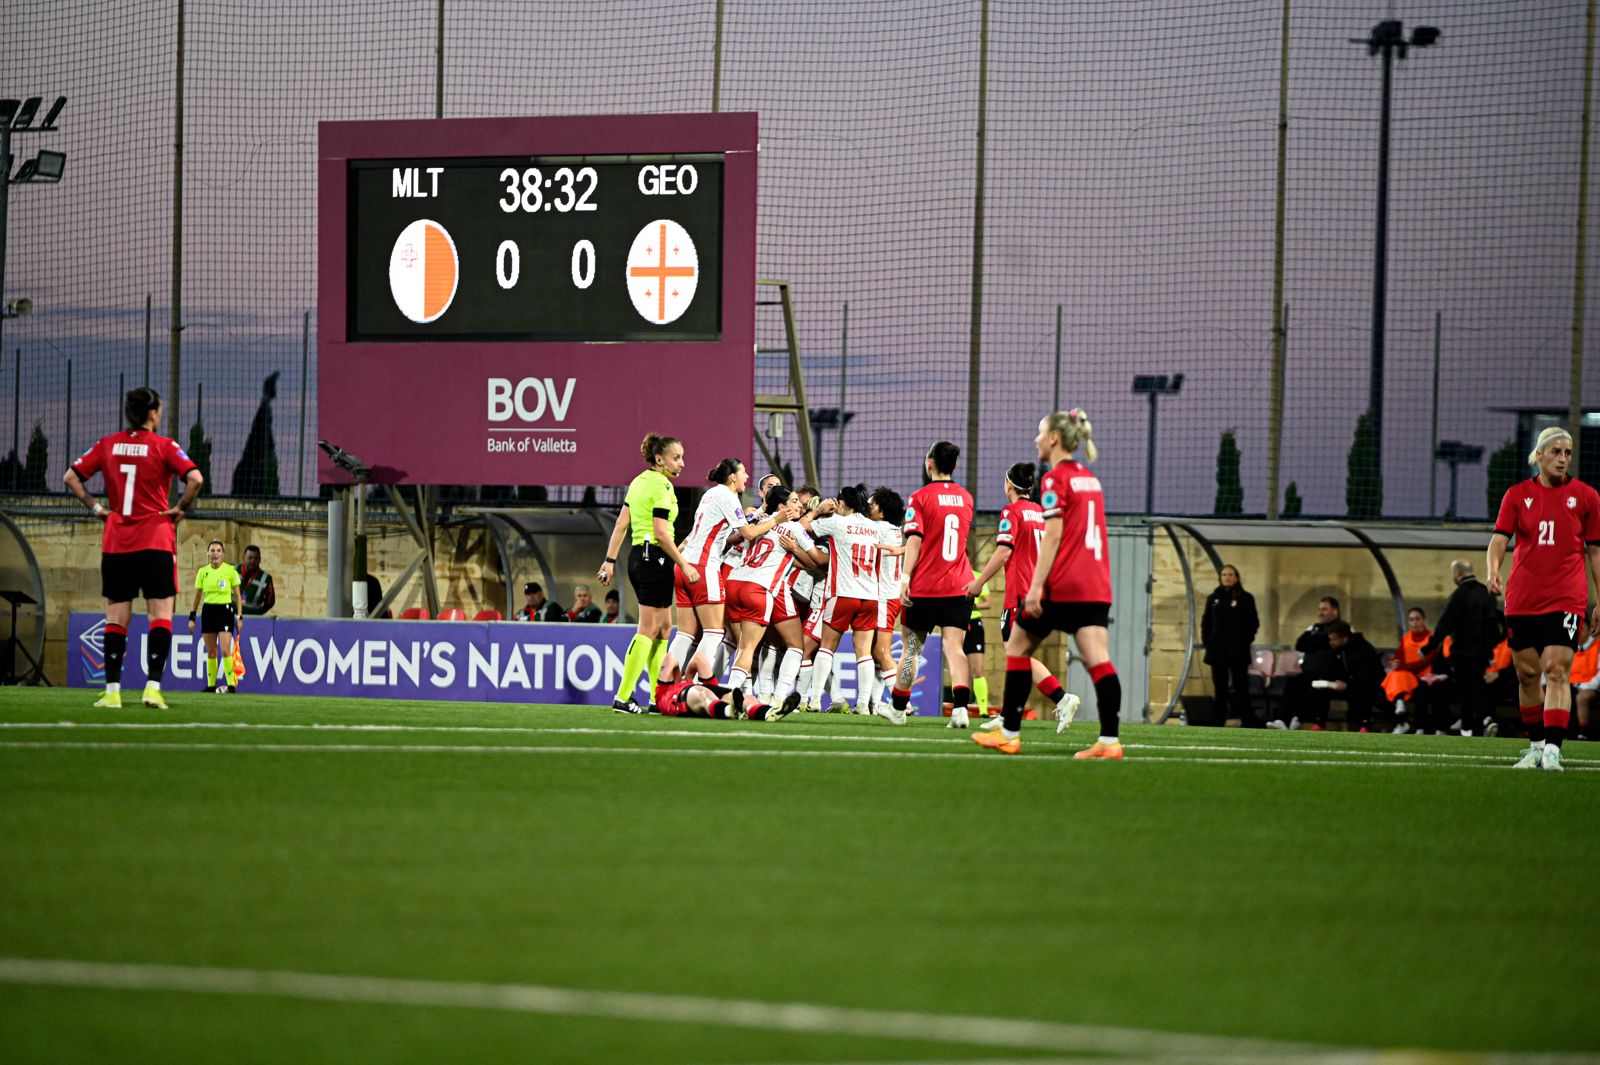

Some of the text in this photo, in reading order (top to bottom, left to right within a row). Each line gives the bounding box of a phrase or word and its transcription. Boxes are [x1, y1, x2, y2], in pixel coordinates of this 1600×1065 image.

[393, 168, 444, 198] MLT
[499, 167, 599, 213] 38:32
[637, 165, 698, 195] GEO
[496, 240, 520, 289] 0
[571, 240, 596, 289] 0
[487, 376, 577, 422] BOV
[487, 437, 577, 453] Bank of Valletta
[120, 464, 137, 516] 7
[741, 537, 775, 569] 10
[942, 513, 960, 562] 6
[1084, 500, 1103, 561] 4
[1538, 520, 1555, 545] 21
[851, 543, 875, 578] 14
[1563, 611, 1578, 630] 21
[250, 636, 456, 688] WOMEN'S
[467, 641, 651, 693] NATION
